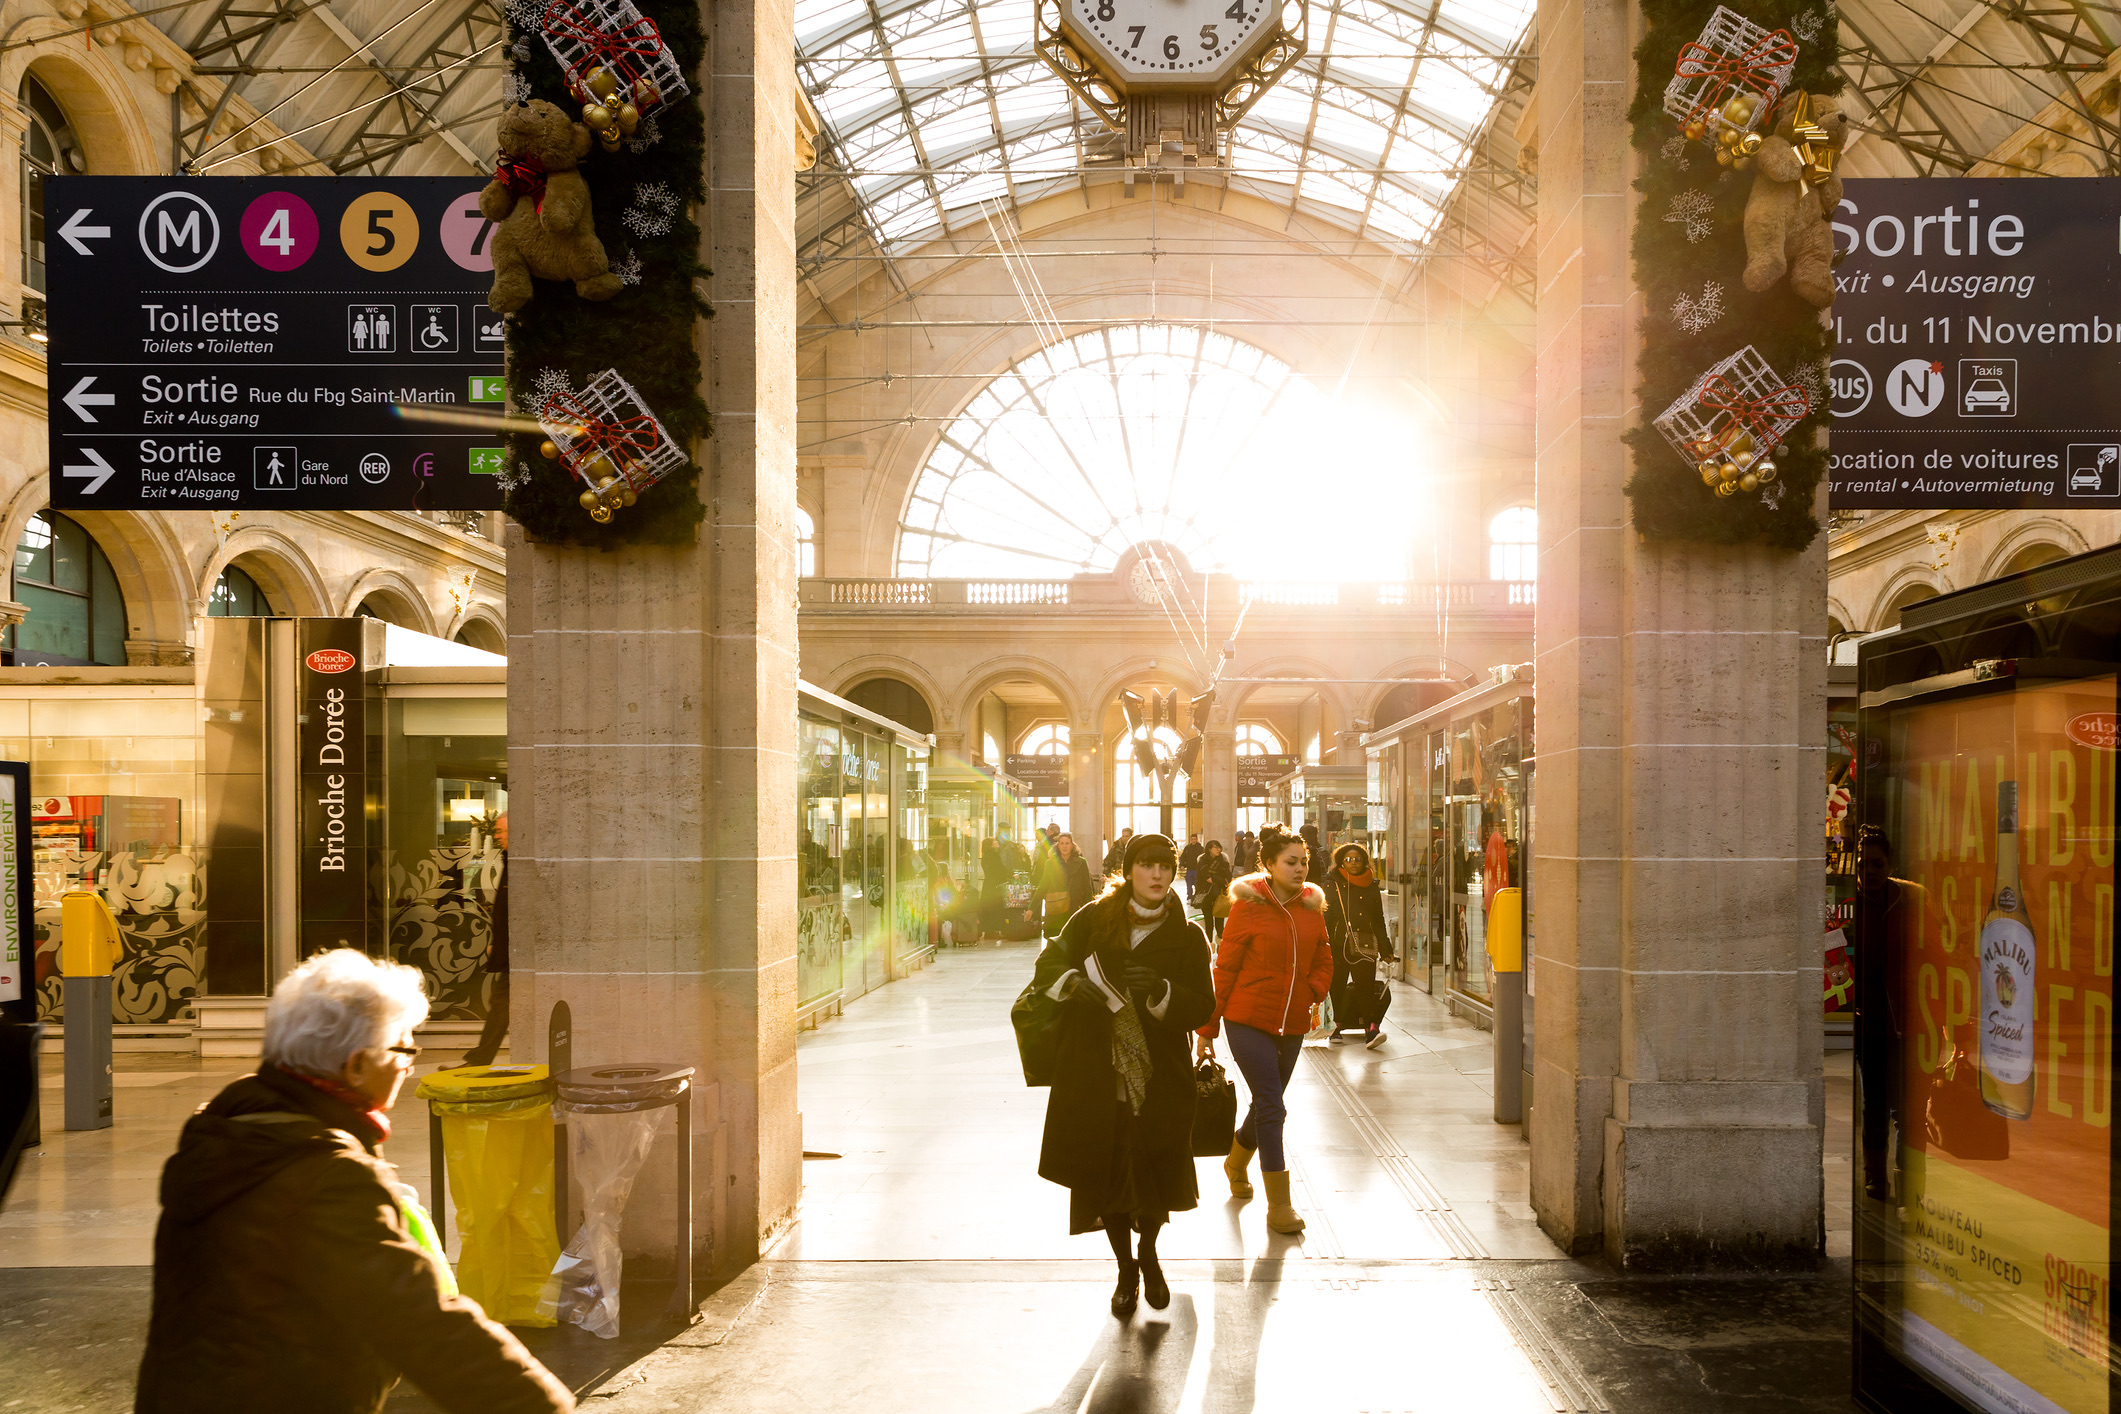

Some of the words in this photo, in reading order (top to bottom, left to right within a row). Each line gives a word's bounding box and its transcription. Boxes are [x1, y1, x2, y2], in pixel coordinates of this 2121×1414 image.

[1127, 25, 1147, 49] 7
[1162, 35, 1181, 60] 6
[1199, 24, 1220, 51] 5
[157, 209, 201, 255] M
[259, 209, 296, 256] 4
[366, 209, 396, 256] 5
[464, 209, 494, 256] 7
[1831, 197, 2025, 258] Sortie
[1831, 269, 1872, 294] xit
[1905, 269, 2036, 299] Ausgang
[141, 304, 280, 333] Toilettes
[364, 306, 379, 314] WC
[427, 306, 442, 314] WC
[1830, 316, 1853, 344] l.
[1866, 316, 1908, 344] du
[1922, 316, 1950, 344] 11
[142, 338, 193, 353] Toilets
[206, 338, 274, 353] Toiletten
[1971, 365, 2004, 377] Taxis
[141, 375, 238, 403] Sortie
[249, 387, 282, 404] Rue
[286, 387, 309, 404] du
[314, 387, 346, 407] Fbg
[351, 387, 456, 404] Saint-Martin
[1900, 369, 1930, 407] N
[143, 410, 175, 425] Exit
[187, 410, 260, 428] Ausgang
[140, 439, 222, 464] Sortie
[1829, 449, 1915, 471] ocation
[1923, 449, 1953, 470] de
[1960, 449, 2060, 470] voitures
[141, 468, 171, 482] Rue
[174, 468, 236, 482] d'Alsace
[301, 460, 329, 472] Gare
[363, 462, 387, 475] RER
[301, 473, 318, 485] du
[320, 473, 348, 485] Nord
[1829, 481, 1844, 493] ar
[1846, 477, 1898, 494] rental
[1911, 477, 2055, 497] Autovermietung
[141, 485, 168, 498] Exit
[178, 485, 240, 500] Ausgang
[314, 652, 350, 664] Brioche
[319, 688, 346, 766] Dorée
[1016, 757, 1037, 765] Parking
[1238, 756, 1267, 766] Sortie
[319, 774, 346, 872] Brioche
[3, 799, 19, 963] ENVIRONNEMENT
[1984, 939, 2032, 976] MALIBU
[1988, 1010, 2025, 1042] Spiced
[1915, 1192, 1983, 1239] NOUVEAU
[1915, 1219, 1964, 1257] MALIBU
[1971, 1245, 2022, 1286] SPICED
[1915, 1243, 1940, 1270] 35%
[1943, 1263, 1962, 1282] VOL.
